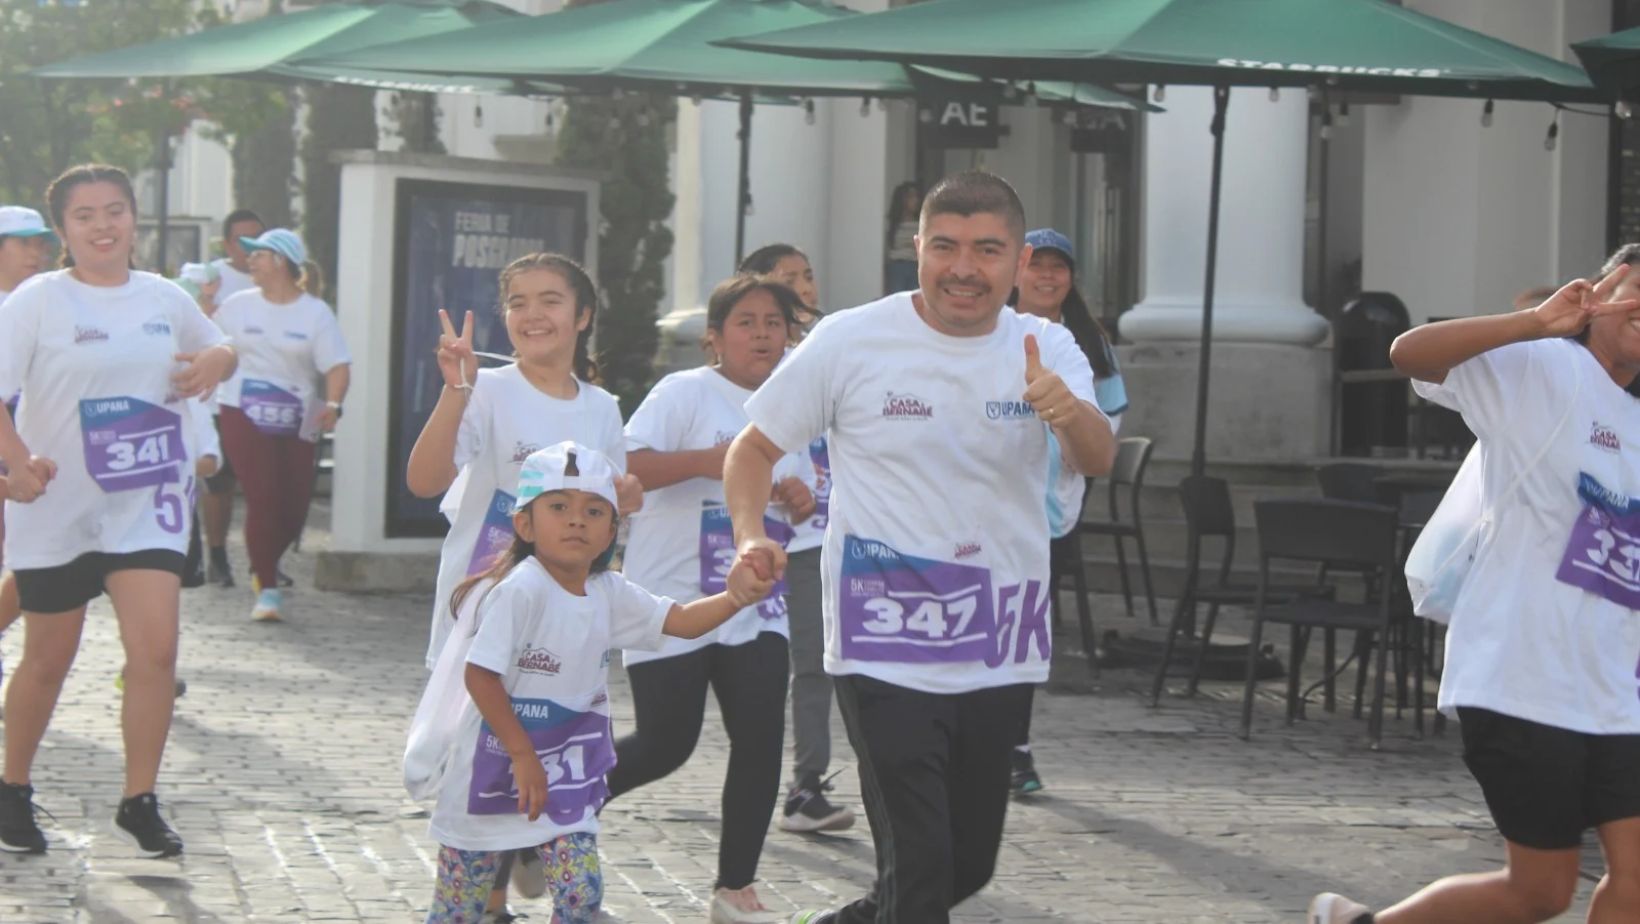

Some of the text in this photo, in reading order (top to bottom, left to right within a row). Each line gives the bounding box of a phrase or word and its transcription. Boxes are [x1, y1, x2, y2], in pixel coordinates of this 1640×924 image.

[97, 401, 129, 413] UPANA
[889, 399, 920, 408] CASA
[105, 434, 169, 470] 341
[154, 476, 195, 534] 5
[862, 595, 977, 638] 347
[985, 579, 1051, 669] 5K
[511, 703, 548, 718] PANA
[508, 745, 586, 792] 31
